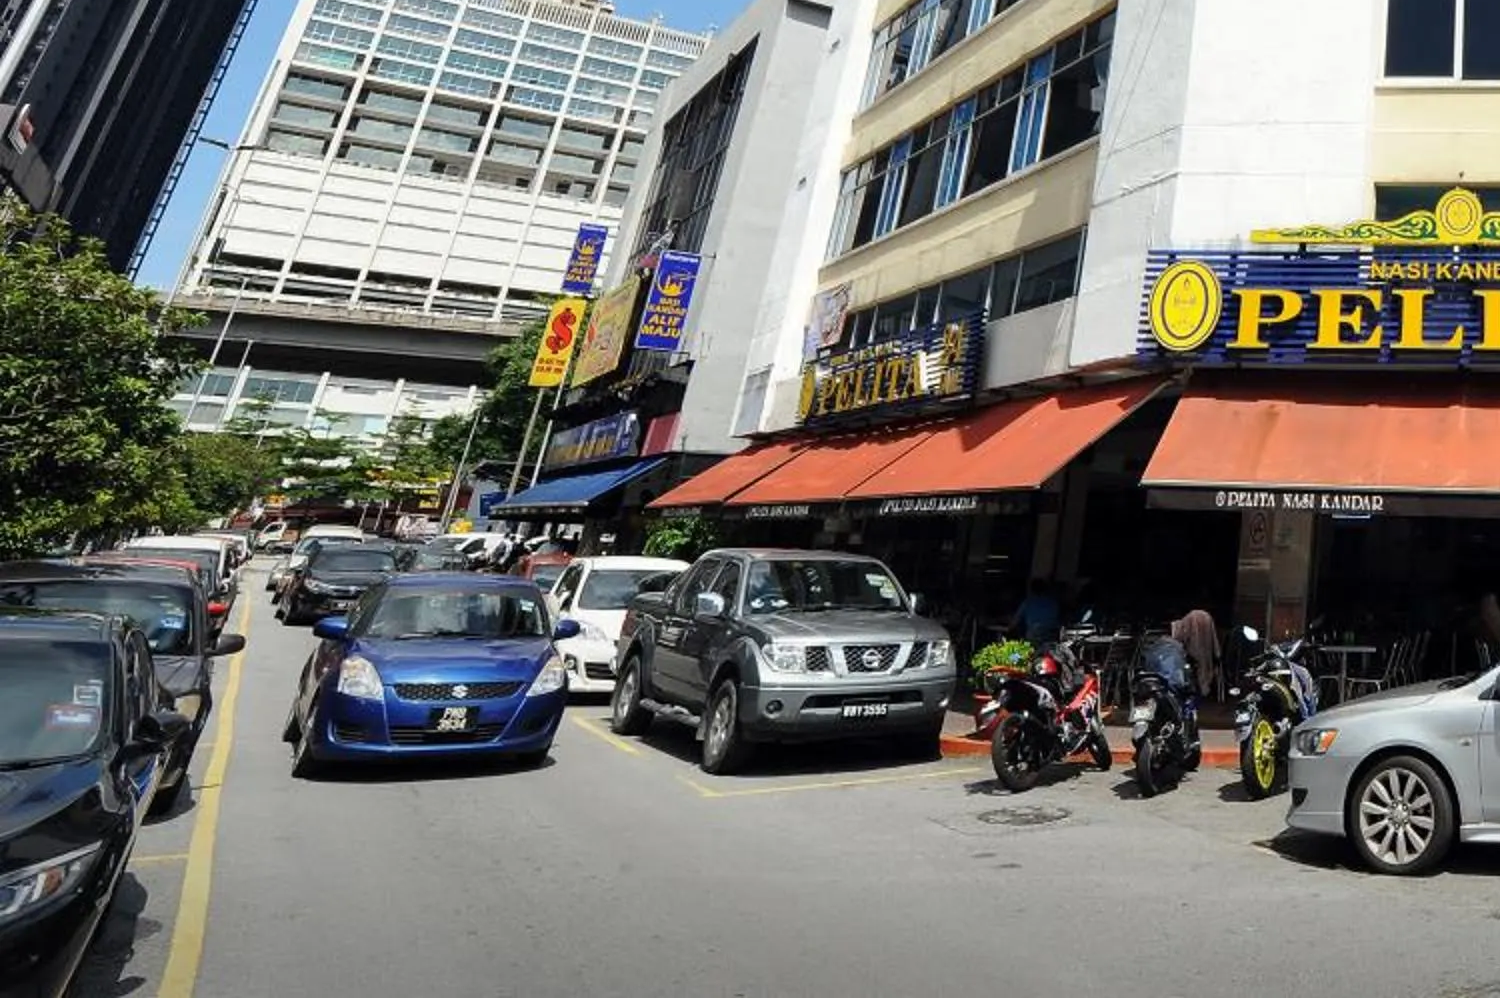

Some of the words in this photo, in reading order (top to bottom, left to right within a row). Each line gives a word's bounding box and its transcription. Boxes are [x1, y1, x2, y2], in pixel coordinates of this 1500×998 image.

[1370, 261, 1429, 279] NASI
[818, 351, 922, 416] PELITA
[1227, 491, 1275, 508] PELITA
[1282, 493, 1315, 510] NASI
[1320, 494, 1384, 511] KANDAR
